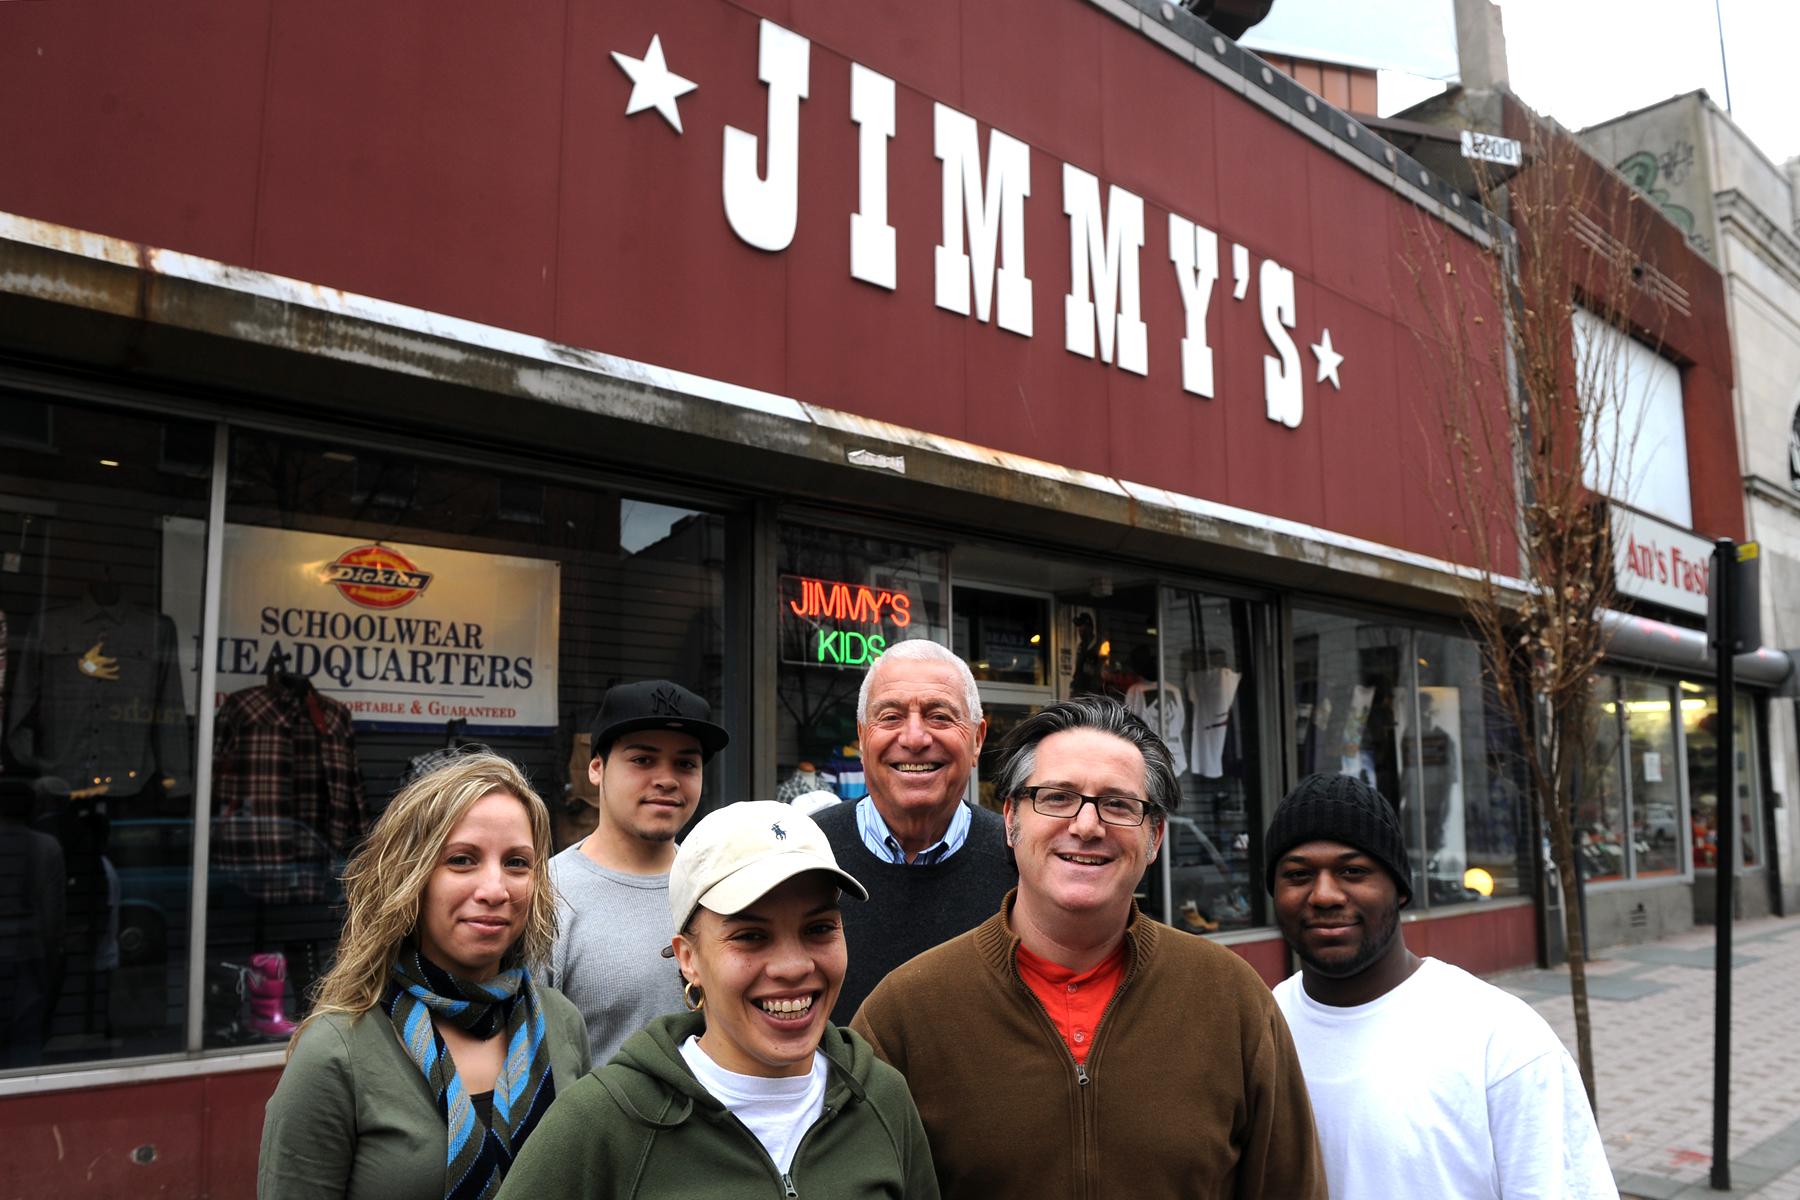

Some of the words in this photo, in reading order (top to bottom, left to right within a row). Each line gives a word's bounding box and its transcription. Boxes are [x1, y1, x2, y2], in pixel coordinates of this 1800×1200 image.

[723, 18, 1303, 430] JIMMY'S
[335, 566, 423, 588] Dickies
[790, 579, 911, 627] JIMMY'S
[260, 606, 484, 650] SCHOOLWEAR
[817, 628, 886, 667] KIDS
[410, 700, 422, 715] &
